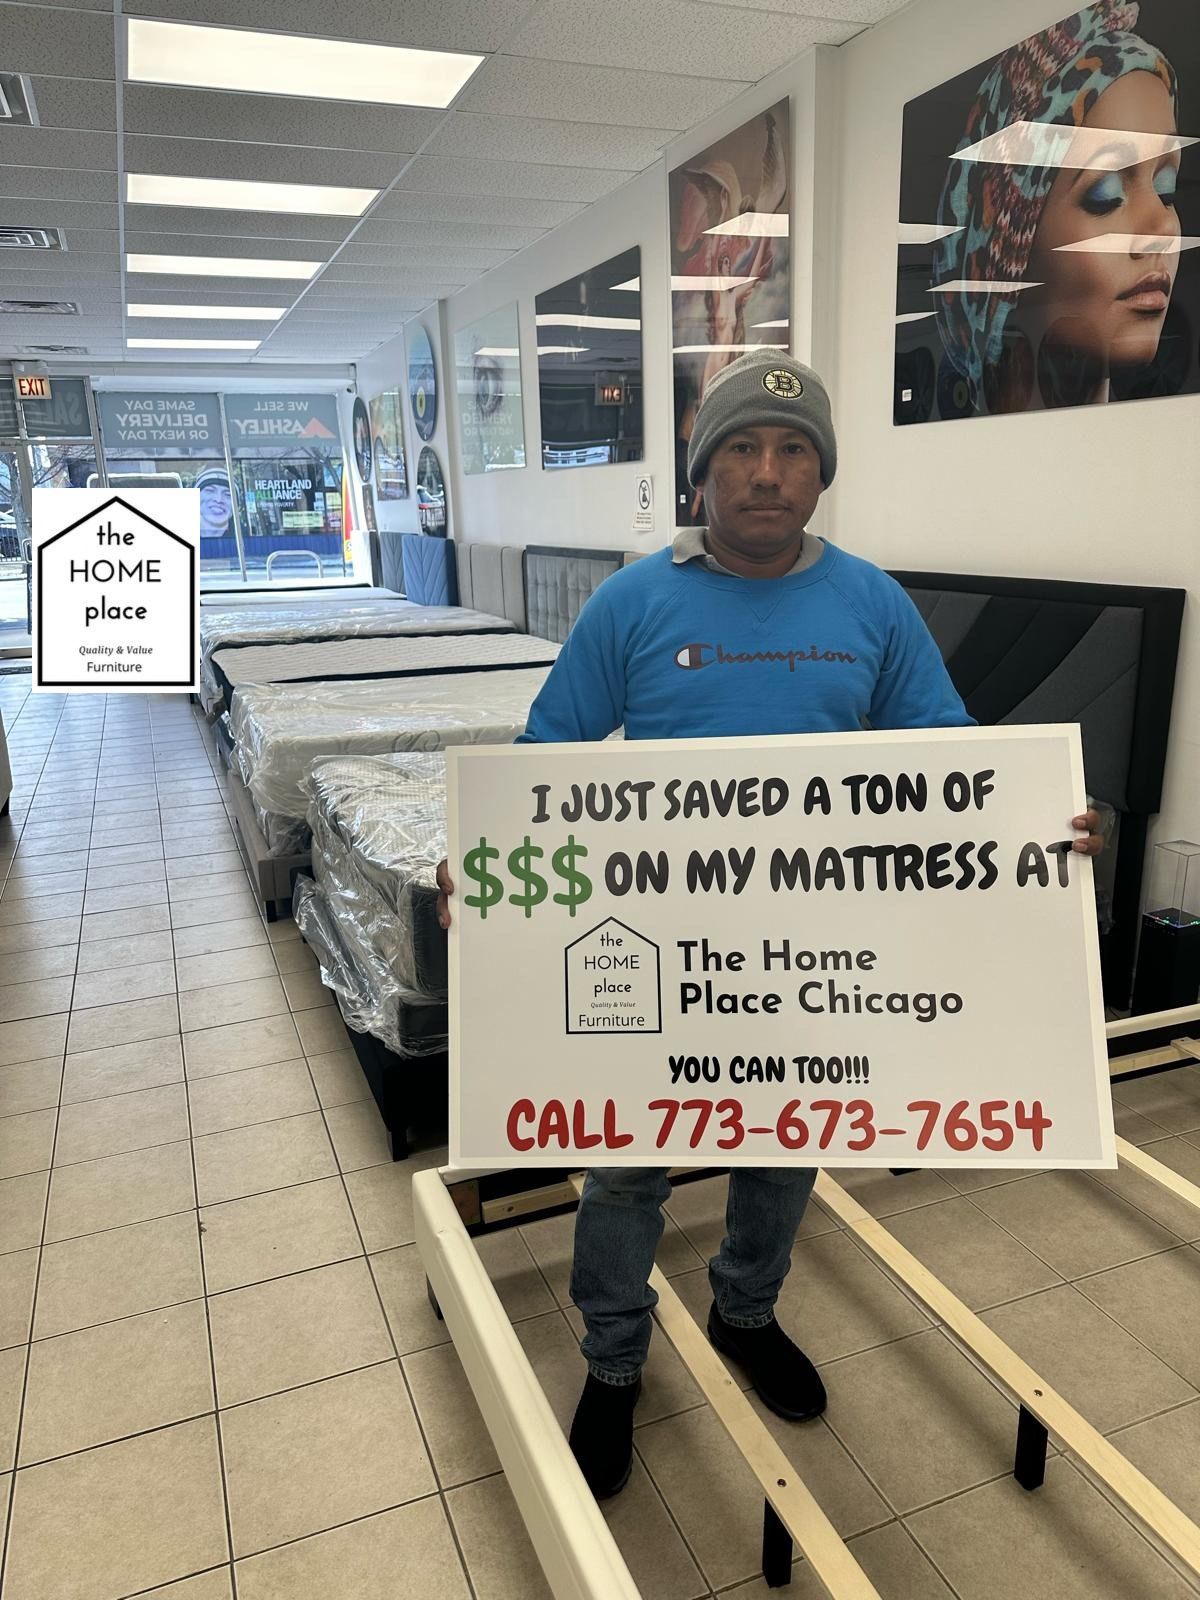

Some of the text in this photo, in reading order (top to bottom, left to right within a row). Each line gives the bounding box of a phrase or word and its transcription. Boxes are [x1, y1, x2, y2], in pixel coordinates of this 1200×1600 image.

[18, 378, 46, 396] EXIT
[254, 479, 313, 490] HEARTLAND
[255, 489, 302, 500] ALLIANCE
[673, 643, 857, 672] Champion
[531, 769, 995, 824] I JUST SAVED A TON OF
[462, 834, 1073, 920] $$$ ON MY MATTRESS AT
[600, 931, 624, 947] the
[584, 954, 641, 970] HOME
[676, 938, 878, 972] The Home
[594, 977, 632, 998] place
[590, 1001, 612, 1009] Quality
[680, 978, 963, 1023] Place Chicago
[578, 1013, 645, 1027] Furniture
[668, 1054, 870, 1085] YOU CAN TOO!!!
[506, 1098, 1053, 1152] CALL 773-673-7654
